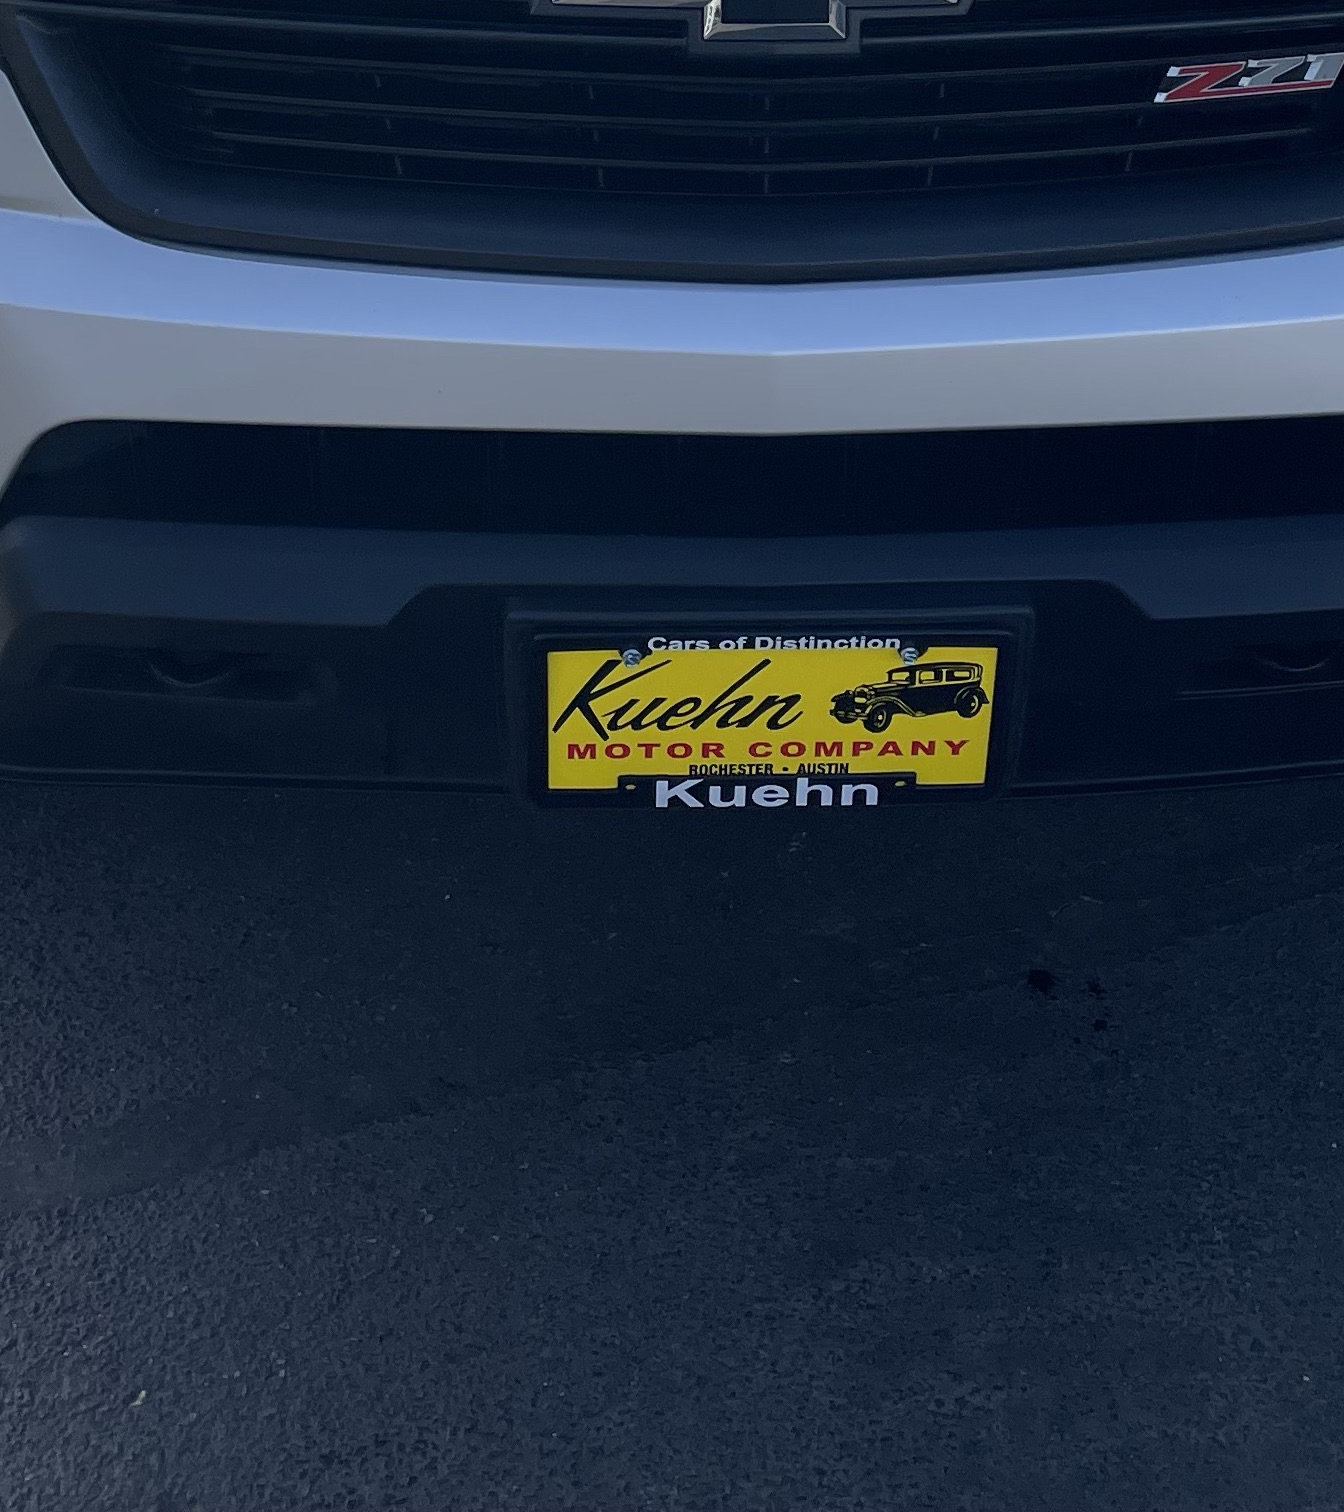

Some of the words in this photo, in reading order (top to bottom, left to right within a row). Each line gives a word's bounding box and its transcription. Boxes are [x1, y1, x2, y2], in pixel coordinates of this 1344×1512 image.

[647, 636, 710, 651] Cars
[718, 636, 748, 650] of
[754, 636, 900, 650] Distinction
[552, 659, 803, 742] Kuehn
[567, 742, 726, 760] MOTOR
[748, 739, 970, 758] COMPANY
[688, 763, 774, 776] ROCHESTER
[796, 762, 850, 775] AUSTIN
[655, 778, 879, 808] Kuehn
